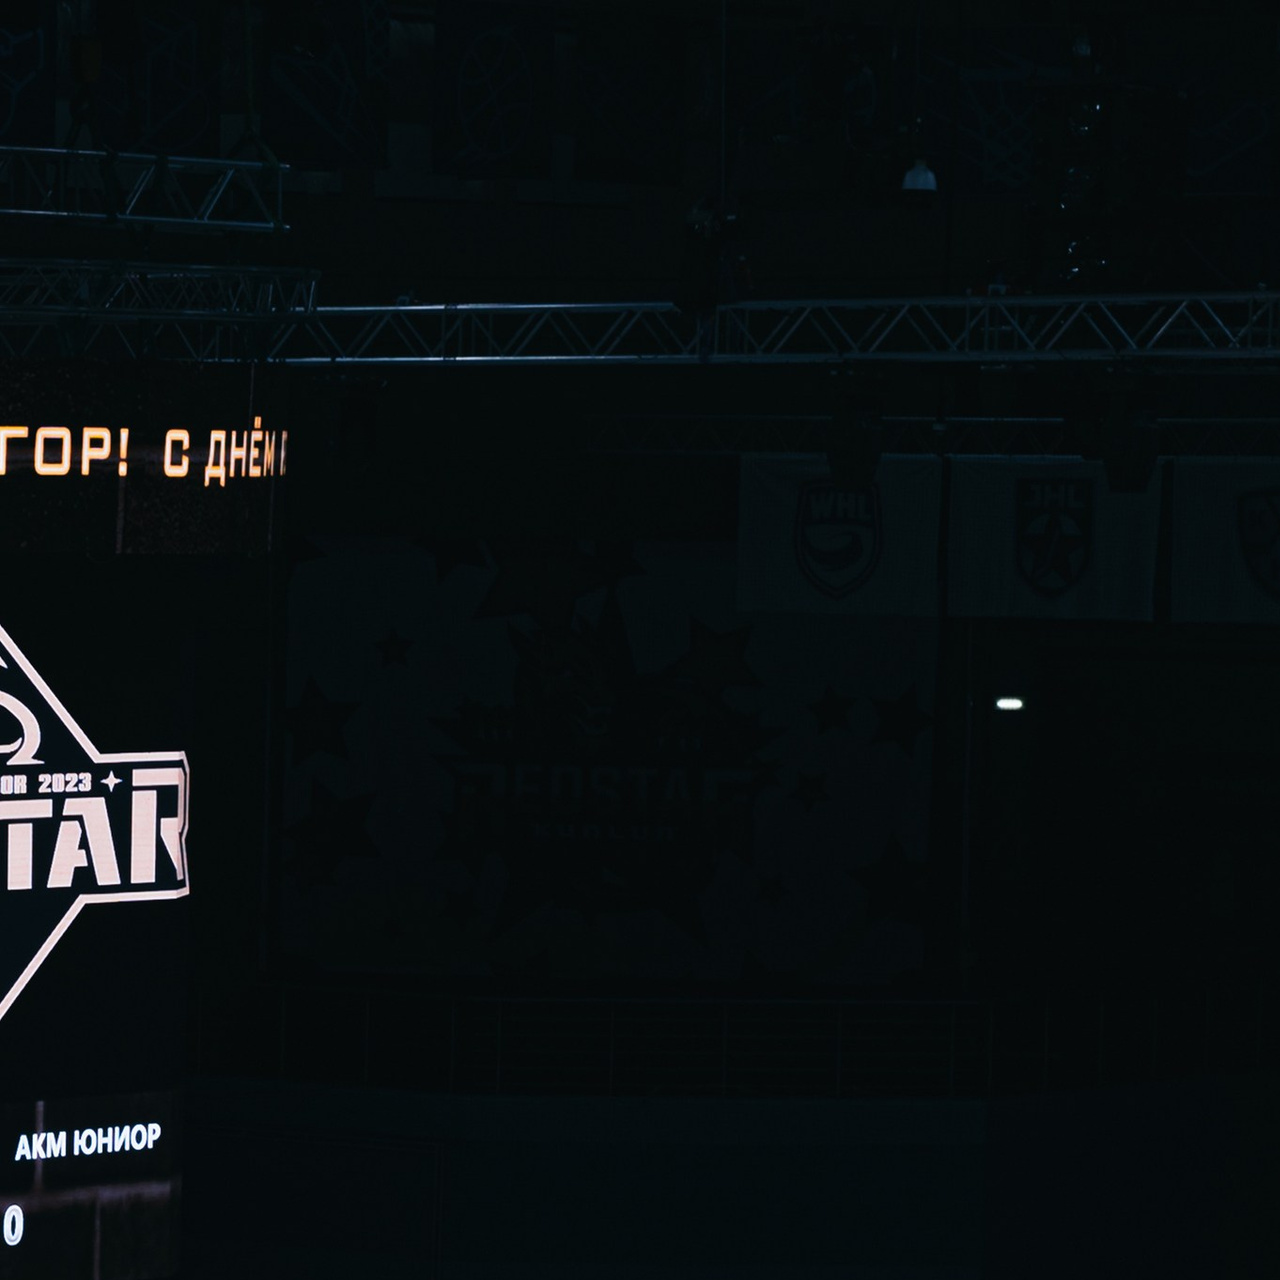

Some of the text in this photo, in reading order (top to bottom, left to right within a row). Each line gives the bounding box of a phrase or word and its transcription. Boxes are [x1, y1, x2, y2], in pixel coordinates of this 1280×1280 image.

[163, 428, 190, 477] С
[204, 416, 276, 487] ДНЁМ
[38, 771, 93, 795] 2023
[14, 1122, 162, 1163] АКМ ЮНИОР
[2, 1204, 25, 1247] 0
